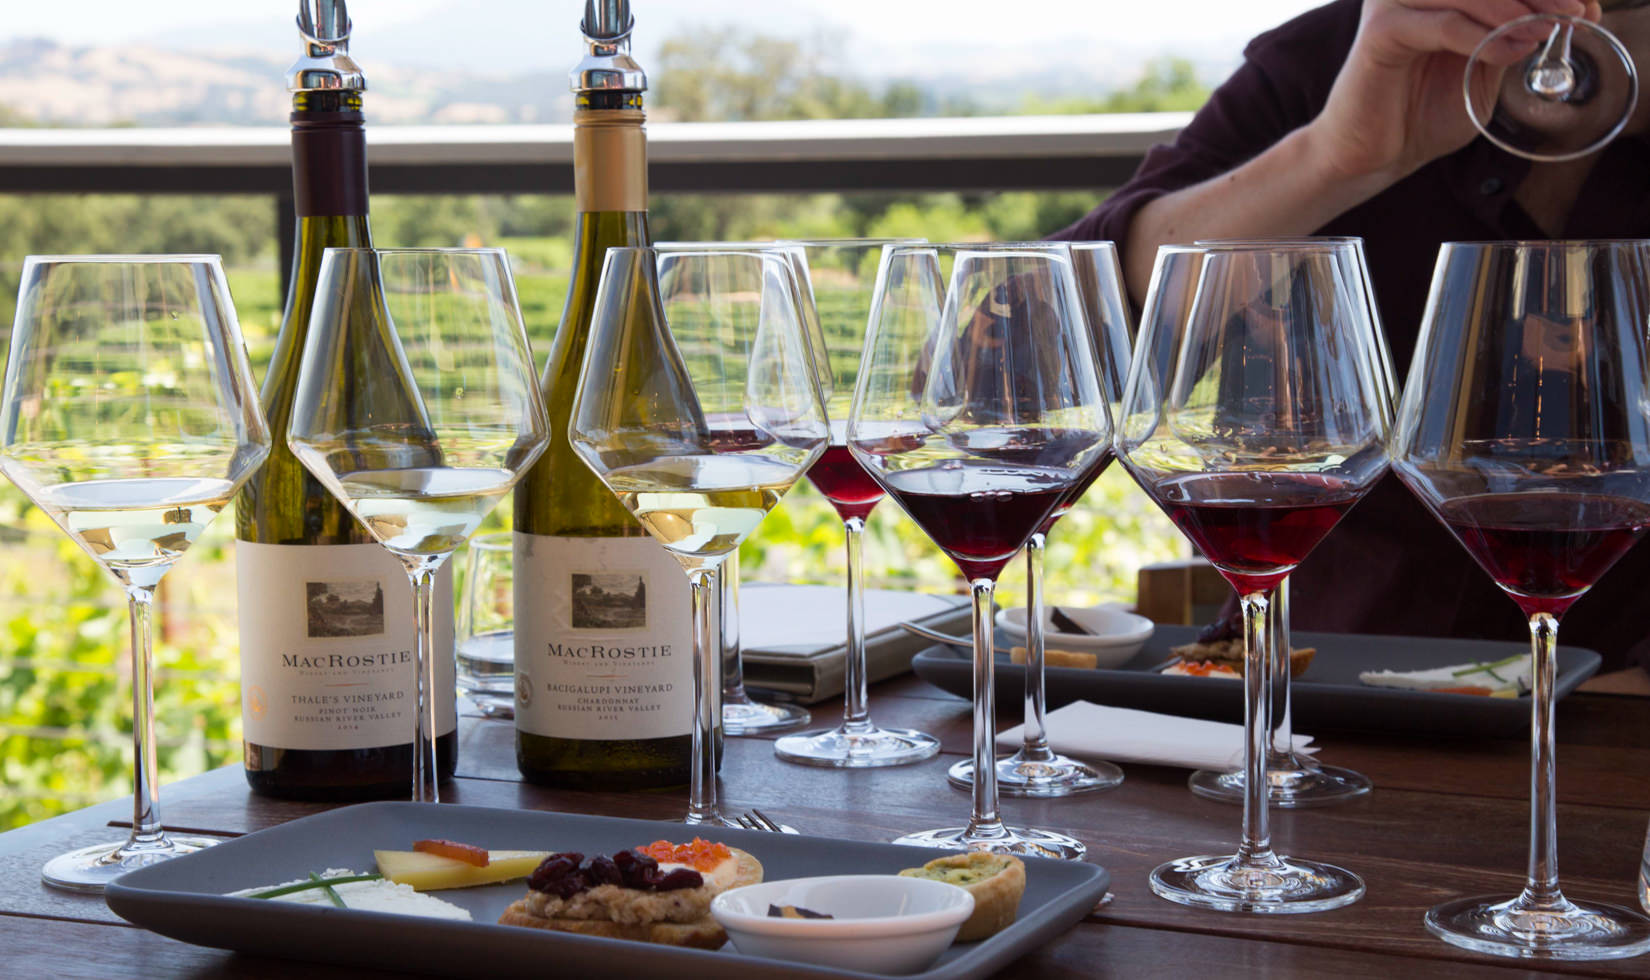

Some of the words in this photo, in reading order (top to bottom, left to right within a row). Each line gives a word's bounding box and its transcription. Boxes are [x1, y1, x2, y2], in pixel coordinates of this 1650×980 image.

[614, 684, 673, 694] VINEYARD
[291, 695, 340, 705] THALE'S
[343, 691, 405, 704] VINEYARD
[557, 704, 593, 712] RUSSIAN
